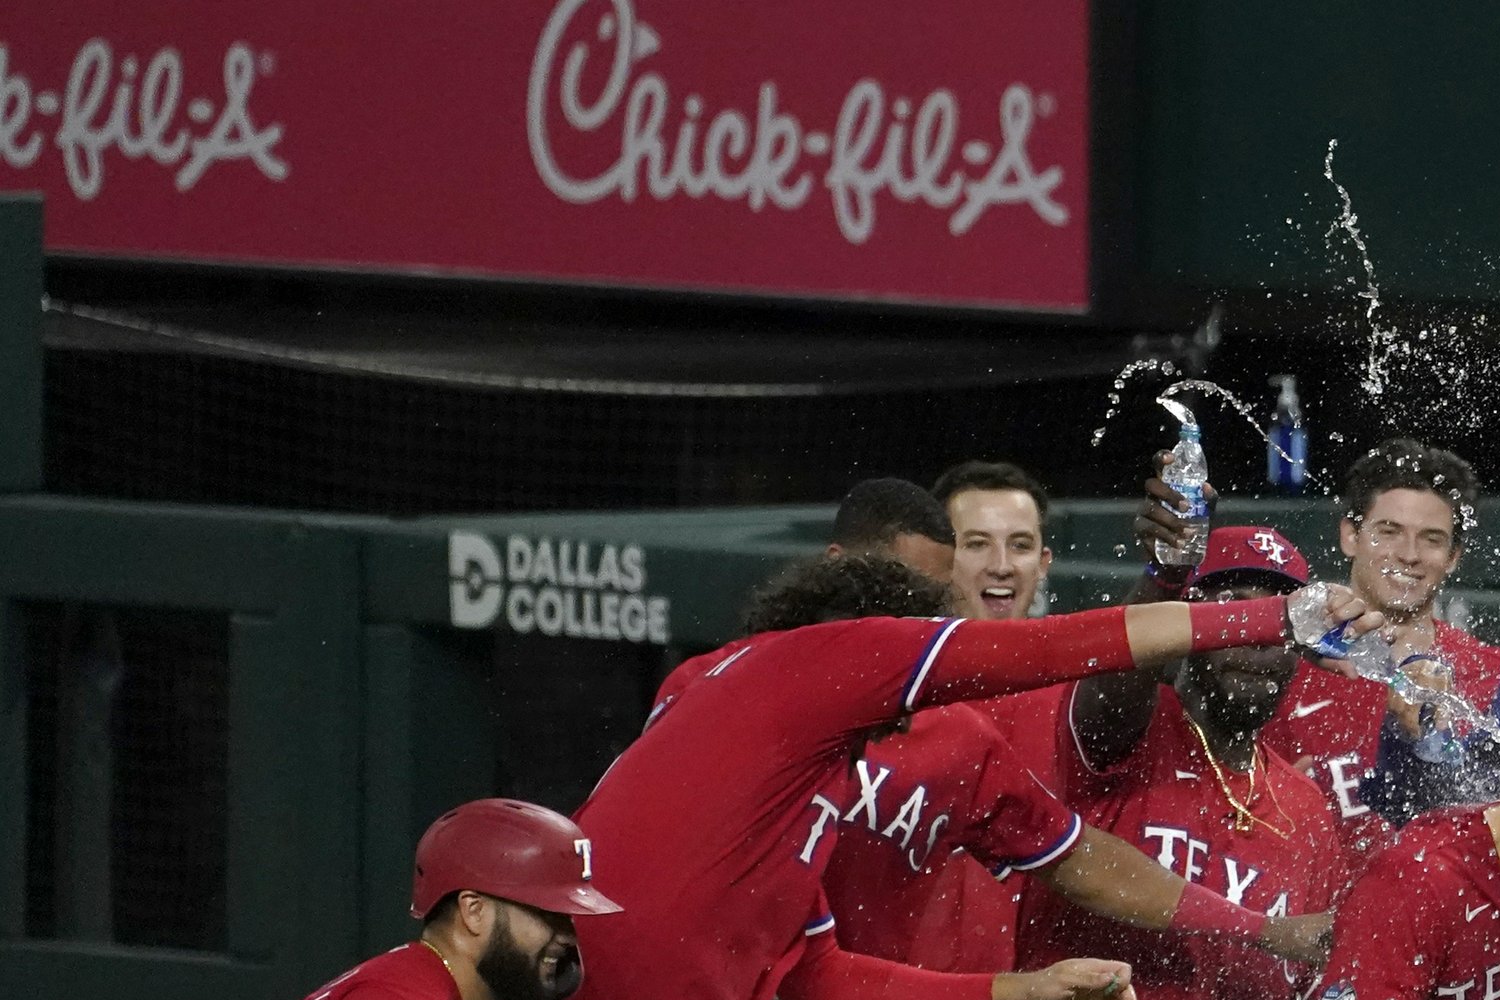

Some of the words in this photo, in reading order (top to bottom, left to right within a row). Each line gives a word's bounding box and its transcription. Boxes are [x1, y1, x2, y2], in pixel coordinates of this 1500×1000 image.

[527, 0, 1068, 244] Chick-fil-A
[507, 534, 647, 592] DALLAS
[506, 585, 667, 643] COLLEGE
[573, 838, 592, 879] T
